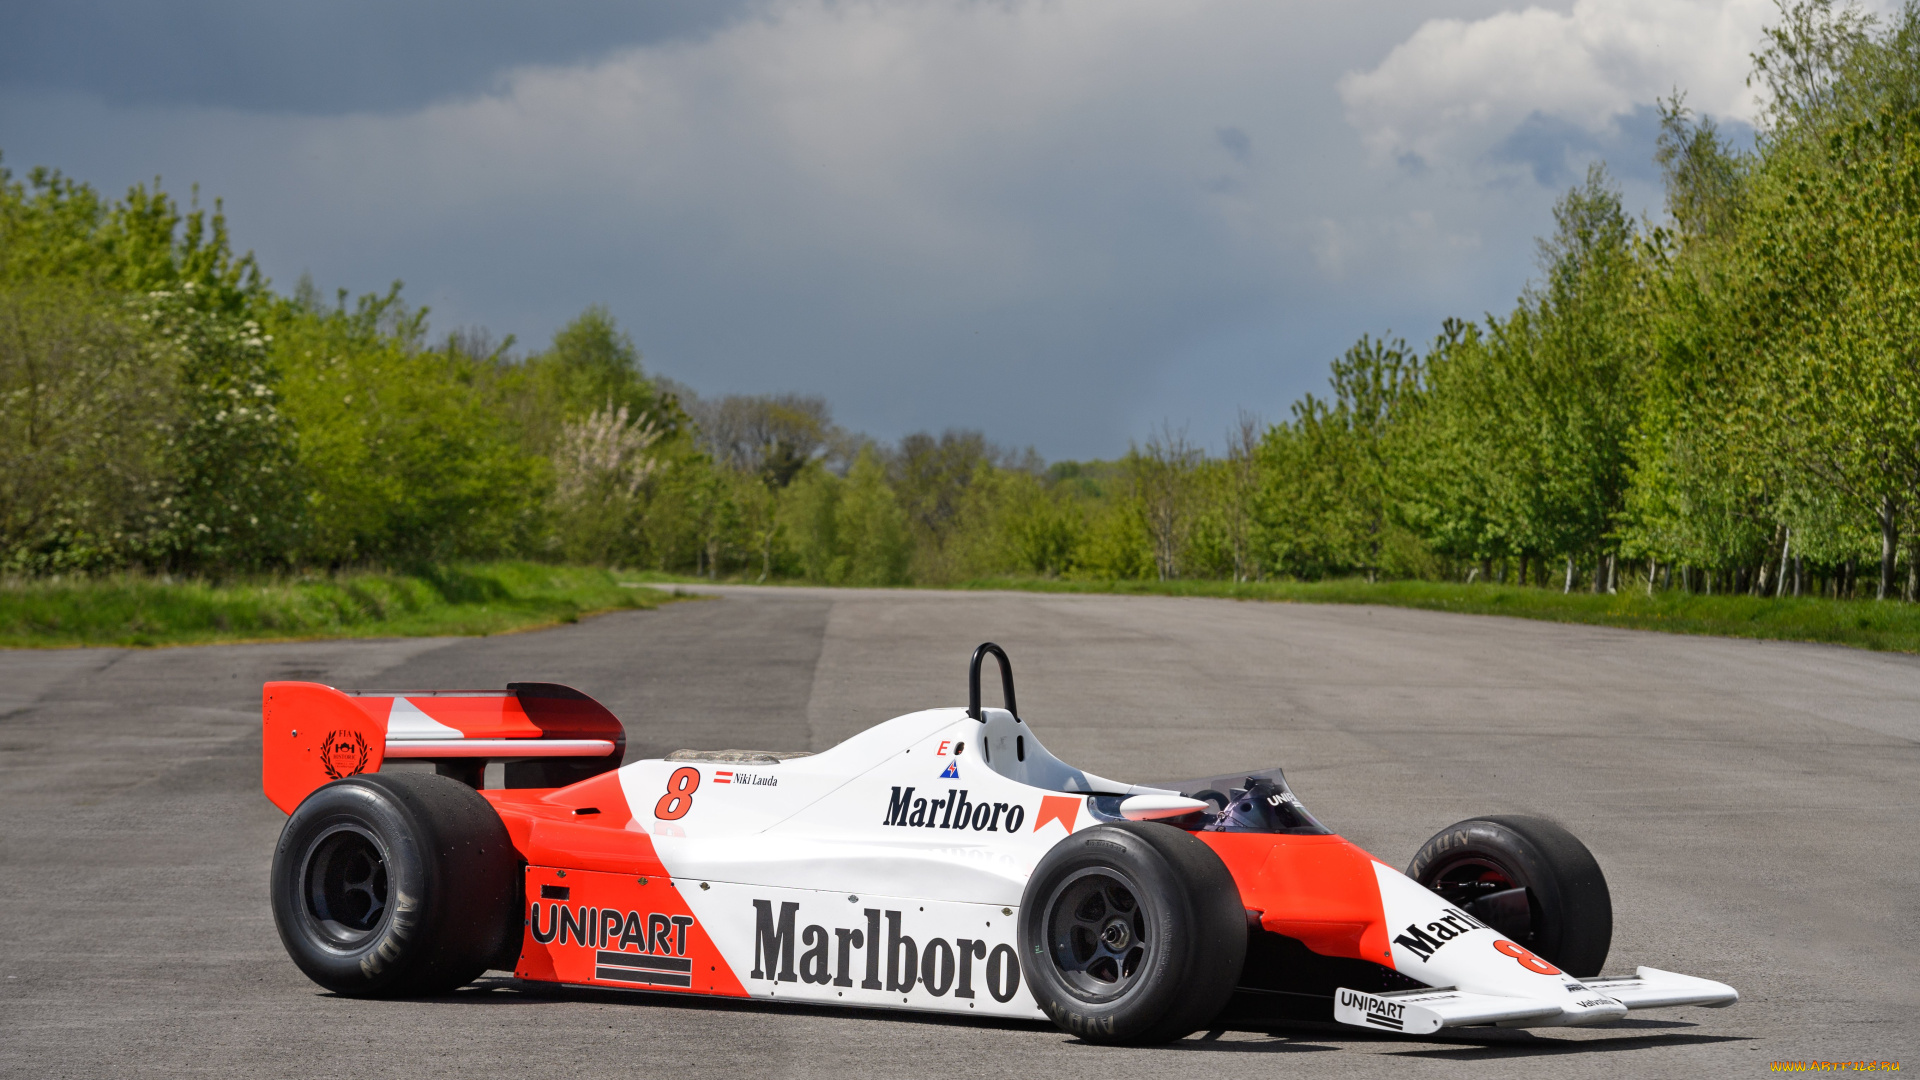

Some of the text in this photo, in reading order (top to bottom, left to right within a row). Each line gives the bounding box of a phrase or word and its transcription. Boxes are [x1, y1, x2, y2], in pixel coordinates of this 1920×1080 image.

[937, 741, 950, 756] E
[654, 766, 701, 821] 8
[733, 773, 778, 787] Niki Lauda
[883, 786, 1025, 834] Marlboro
[1413, 829, 1471, 879] AVON
[531, 902, 693, 957] UNIPART
[751, 899, 1021, 1003] Marlboro
[1493, 939, 1562, 976] 8
[1340, 991, 1406, 1019] UNIPART
